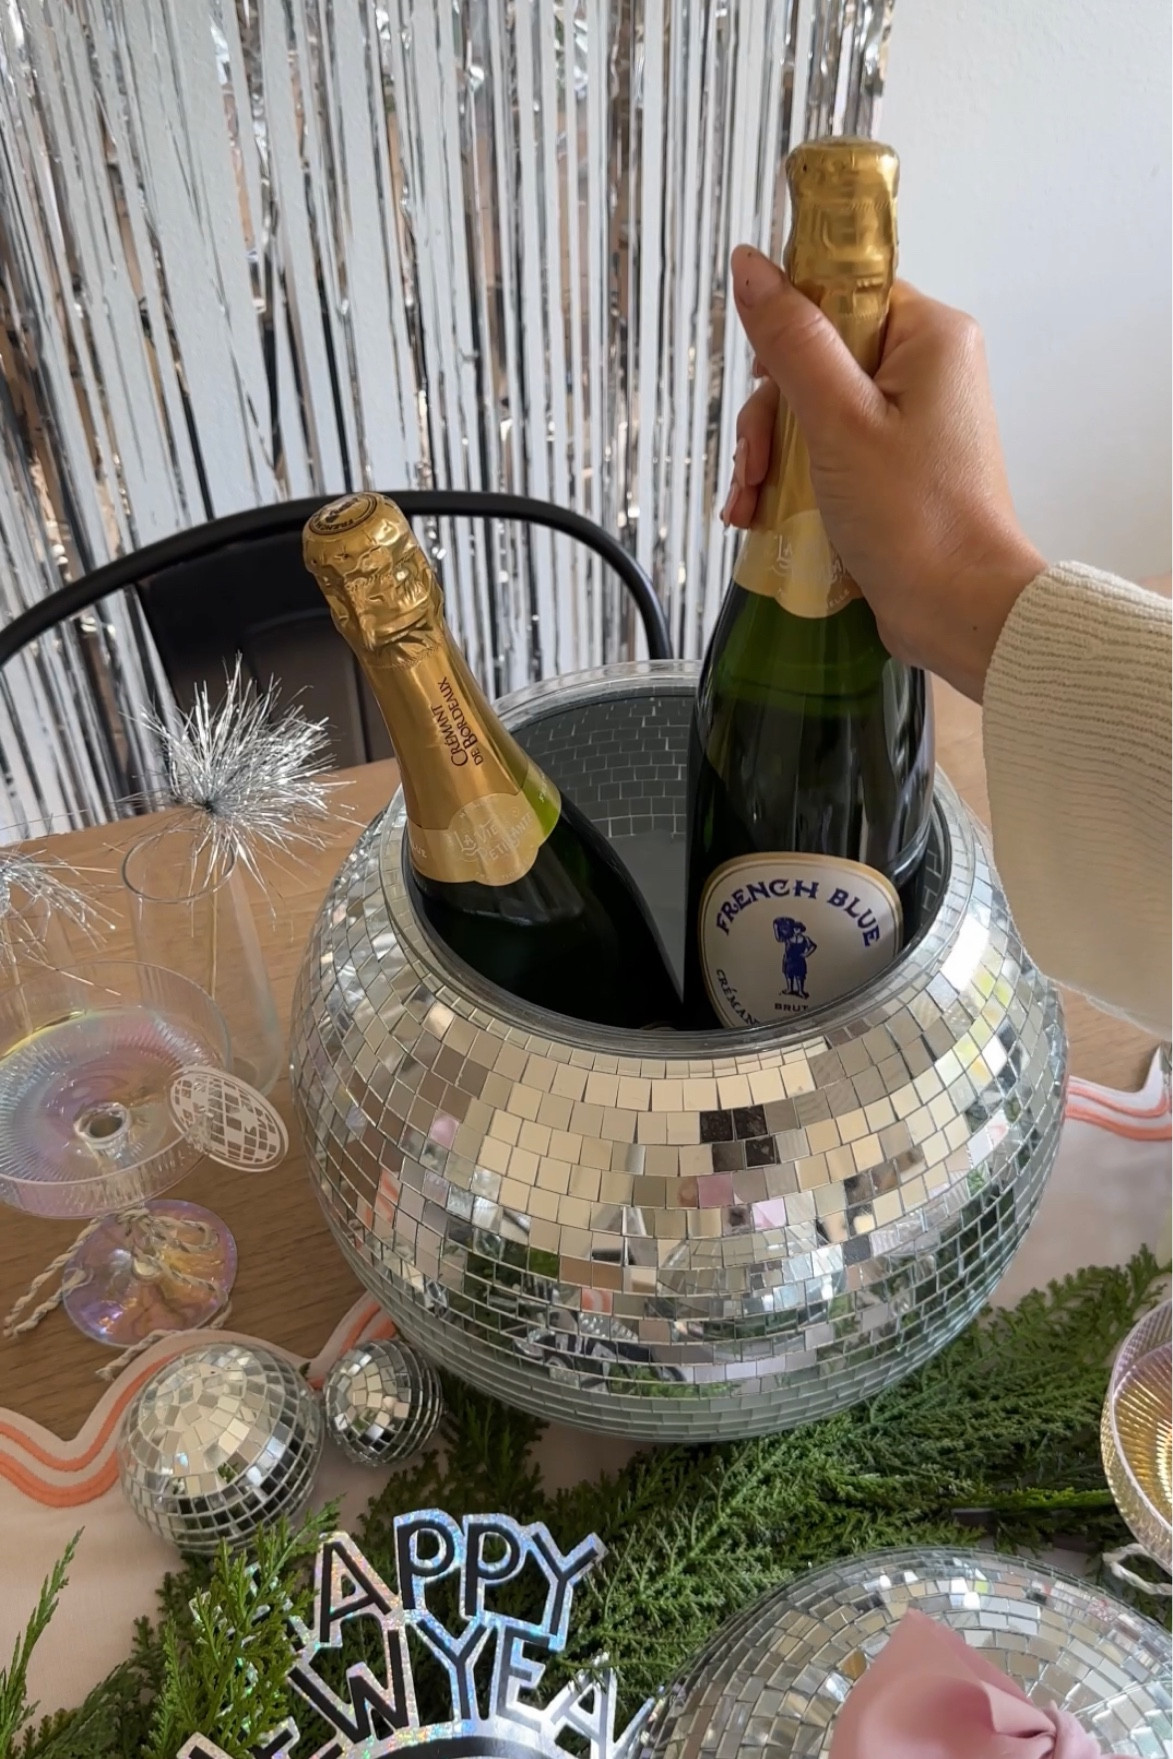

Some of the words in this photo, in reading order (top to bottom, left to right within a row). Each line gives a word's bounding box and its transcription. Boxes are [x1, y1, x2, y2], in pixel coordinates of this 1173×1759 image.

[437, 676, 479, 748] BORDEAUX
[471, 747, 485, 765] DE
[715, 879, 820, 936] FRENCH
[827, 888, 881, 947] BLUE
[774, 1002, 809, 1013] BRUT
[270, 1507, 608, 1650] APPY
